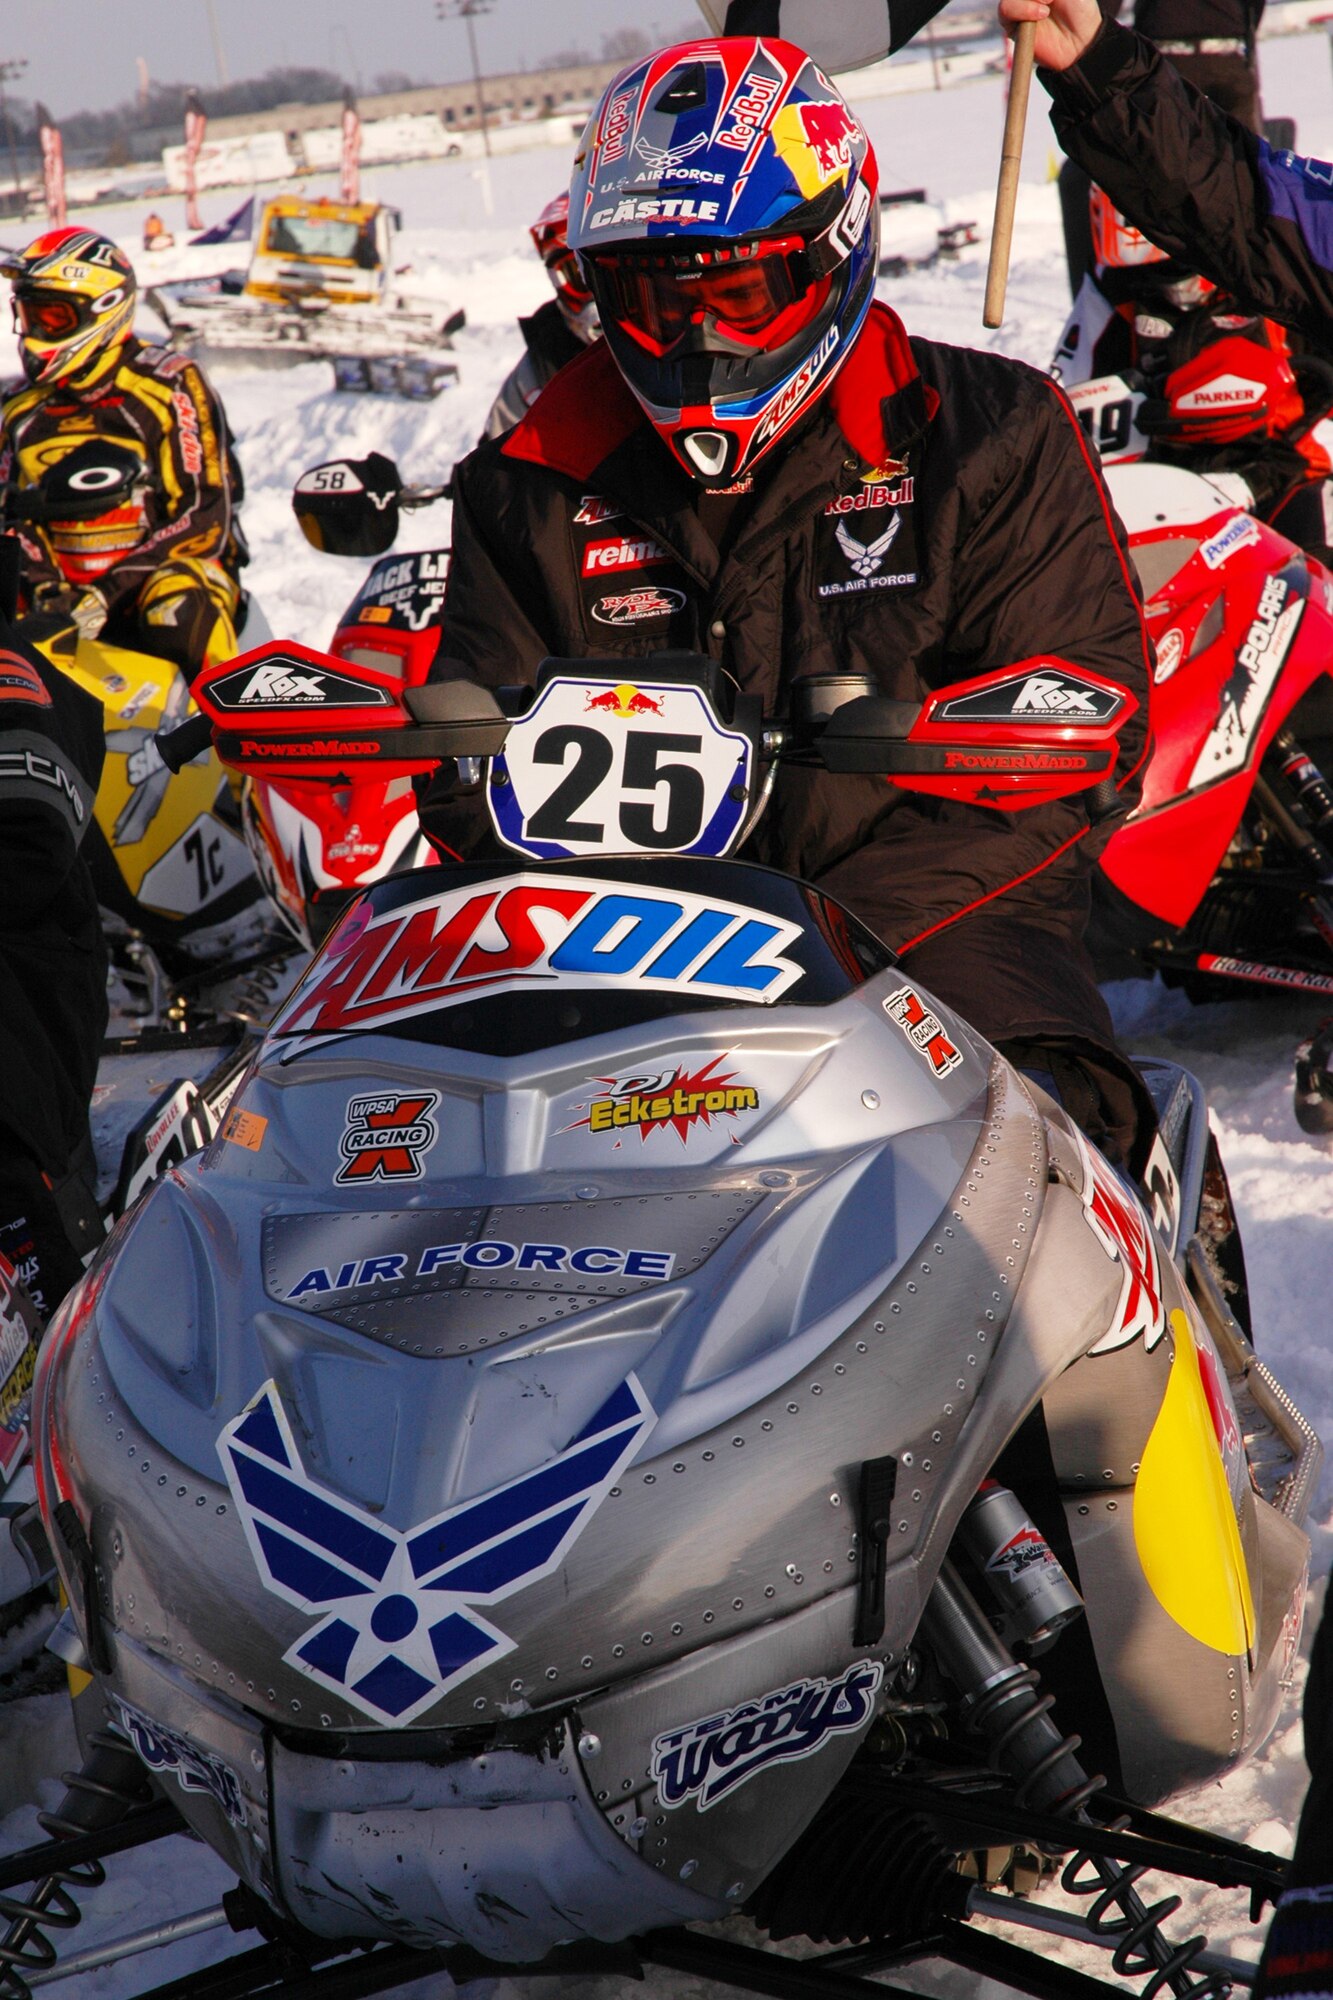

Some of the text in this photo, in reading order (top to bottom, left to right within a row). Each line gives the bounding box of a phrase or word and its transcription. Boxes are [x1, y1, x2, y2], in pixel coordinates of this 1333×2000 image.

[635, 170, 665, 184] AIR
[665, 168, 725, 184] FORCE
[757, 323, 840, 444] AMSOIL
[1193, 389, 1255, 405] PARKER
[313, 472, 345, 490] 58
[870, 476, 915, 508] Bull
[361, 558, 416, 601] JACK
[819, 573, 917, 597] U.S. AIR FORCE
[1239, 575, 1288, 673] POLARIS
[237, 696, 326, 705] SPEEDFX.COM
[1010, 708, 1099, 716] SPEEDFX.COM
[526, 724, 705, 849] 25
[268, 883, 798, 1036] AMSOIL
[609, 1069, 678, 1097] DJ
[352, 1100, 396, 1117] WPSA
[589, 1087, 759, 1132] Eckstrom
[350, 1129, 423, 1148] RACING
[285, 1240, 678, 1300] AIR FORCE
[660, 1685, 804, 1747] TEAM
